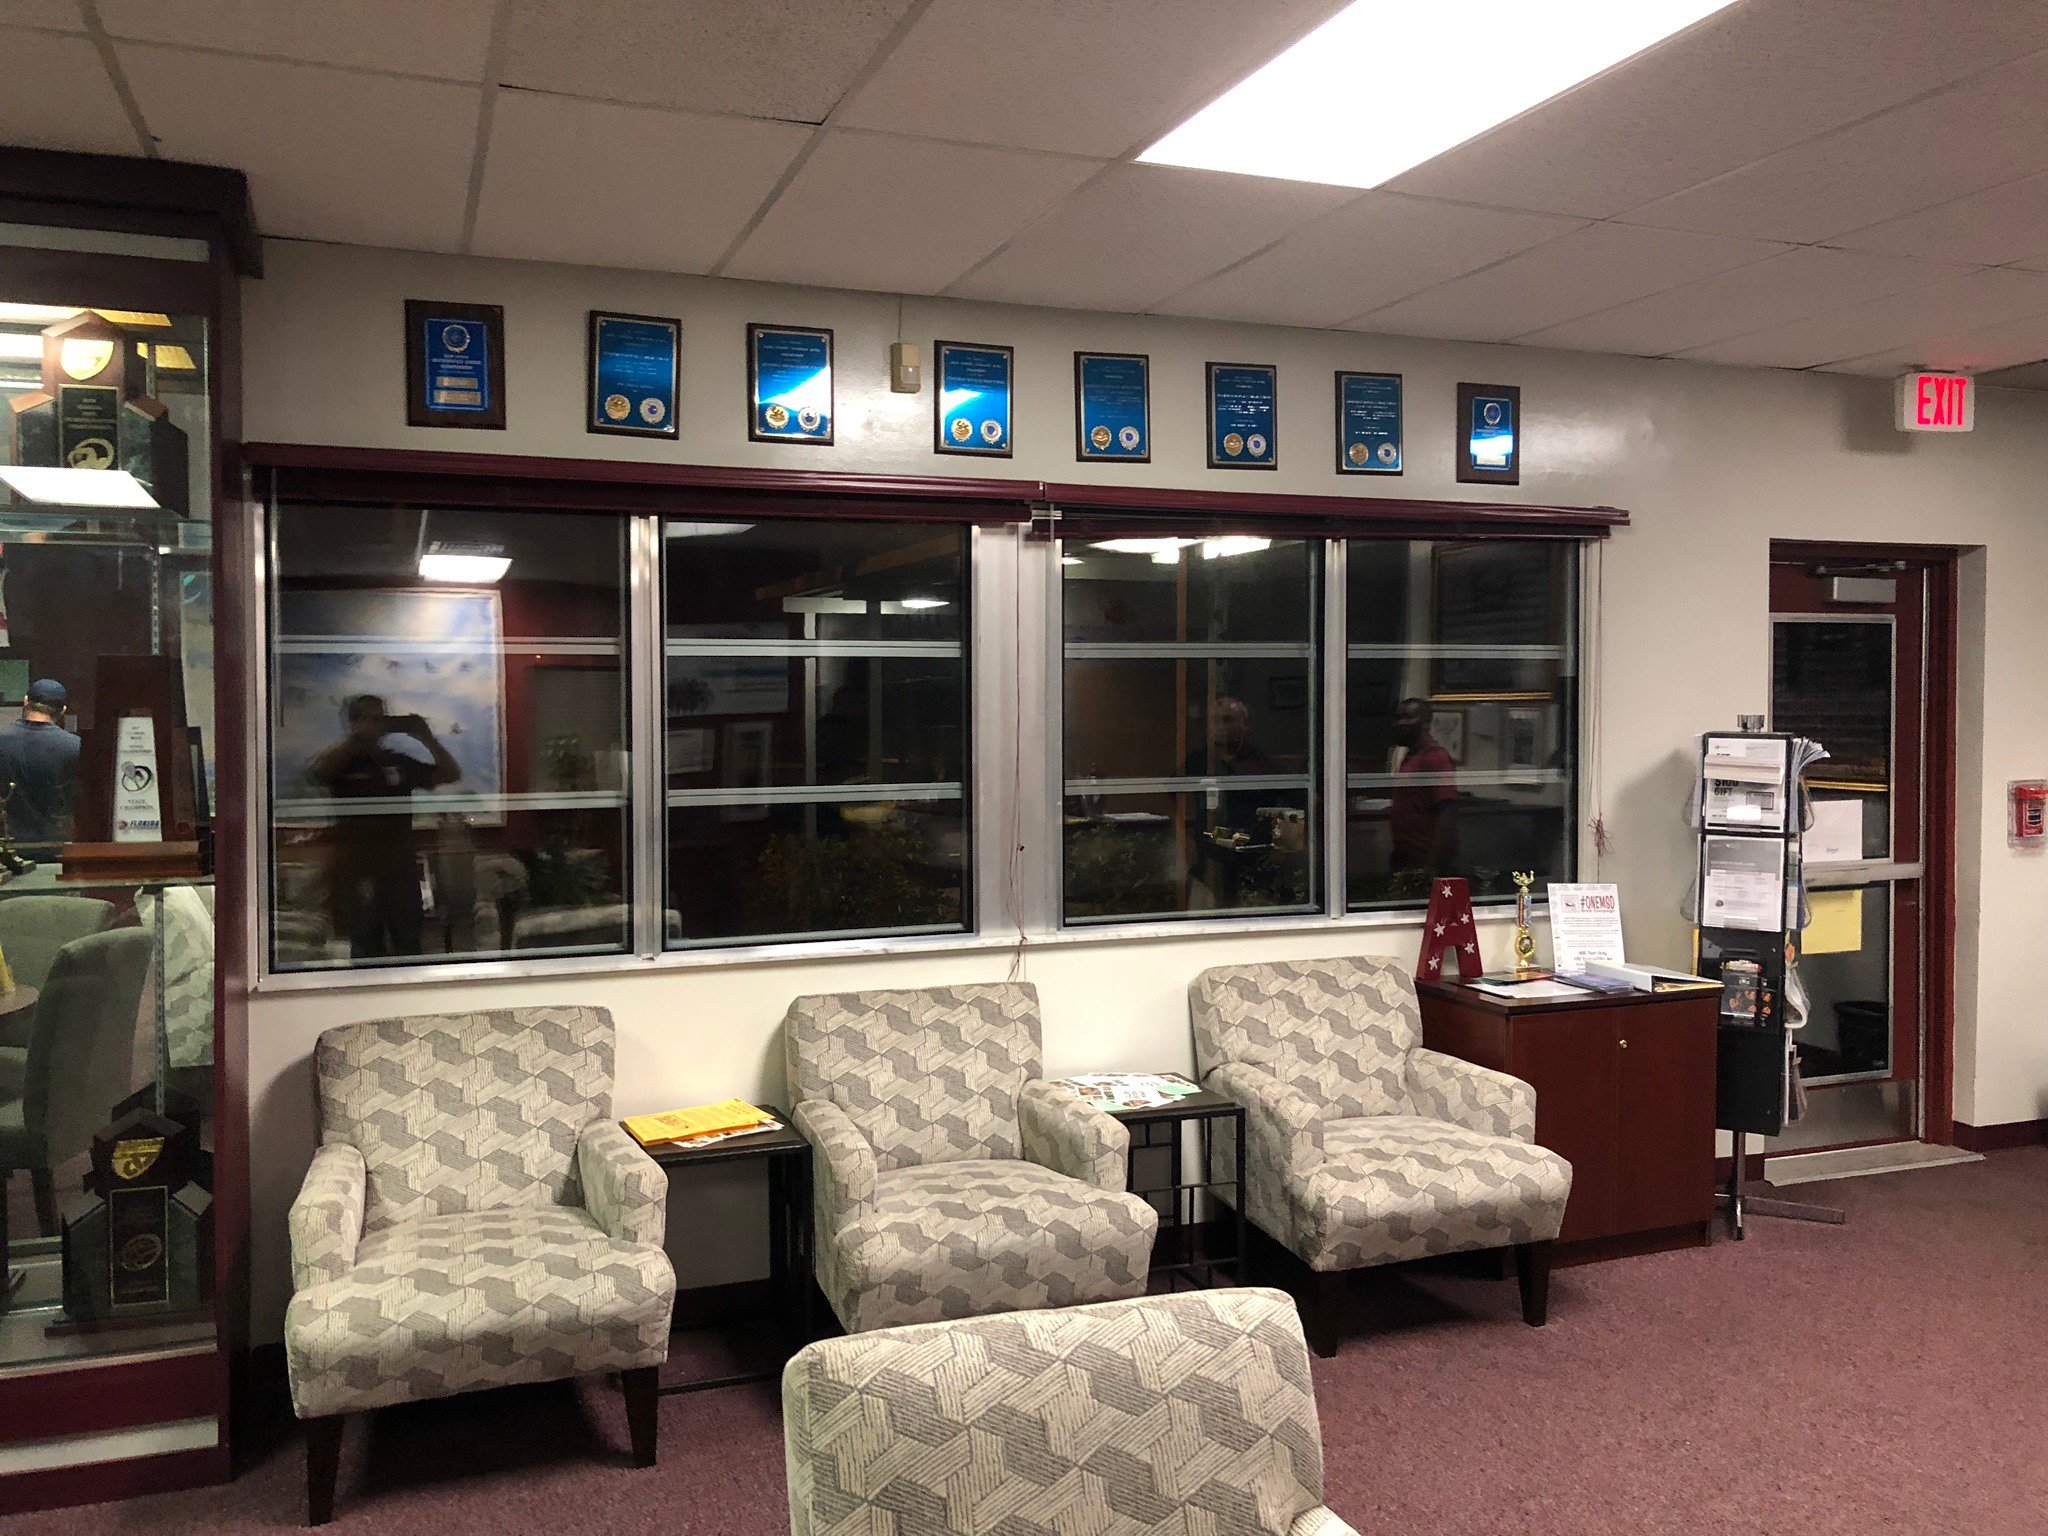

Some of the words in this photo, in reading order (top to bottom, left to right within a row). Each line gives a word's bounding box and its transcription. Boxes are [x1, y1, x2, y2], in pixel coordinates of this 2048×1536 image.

[1917, 376, 1967, 426] EXIT
[1714, 787, 1733, 796] GIFT
[1581, 895, 1614, 909] #ONEMSD
[1416, 877, 1483, 981] A
